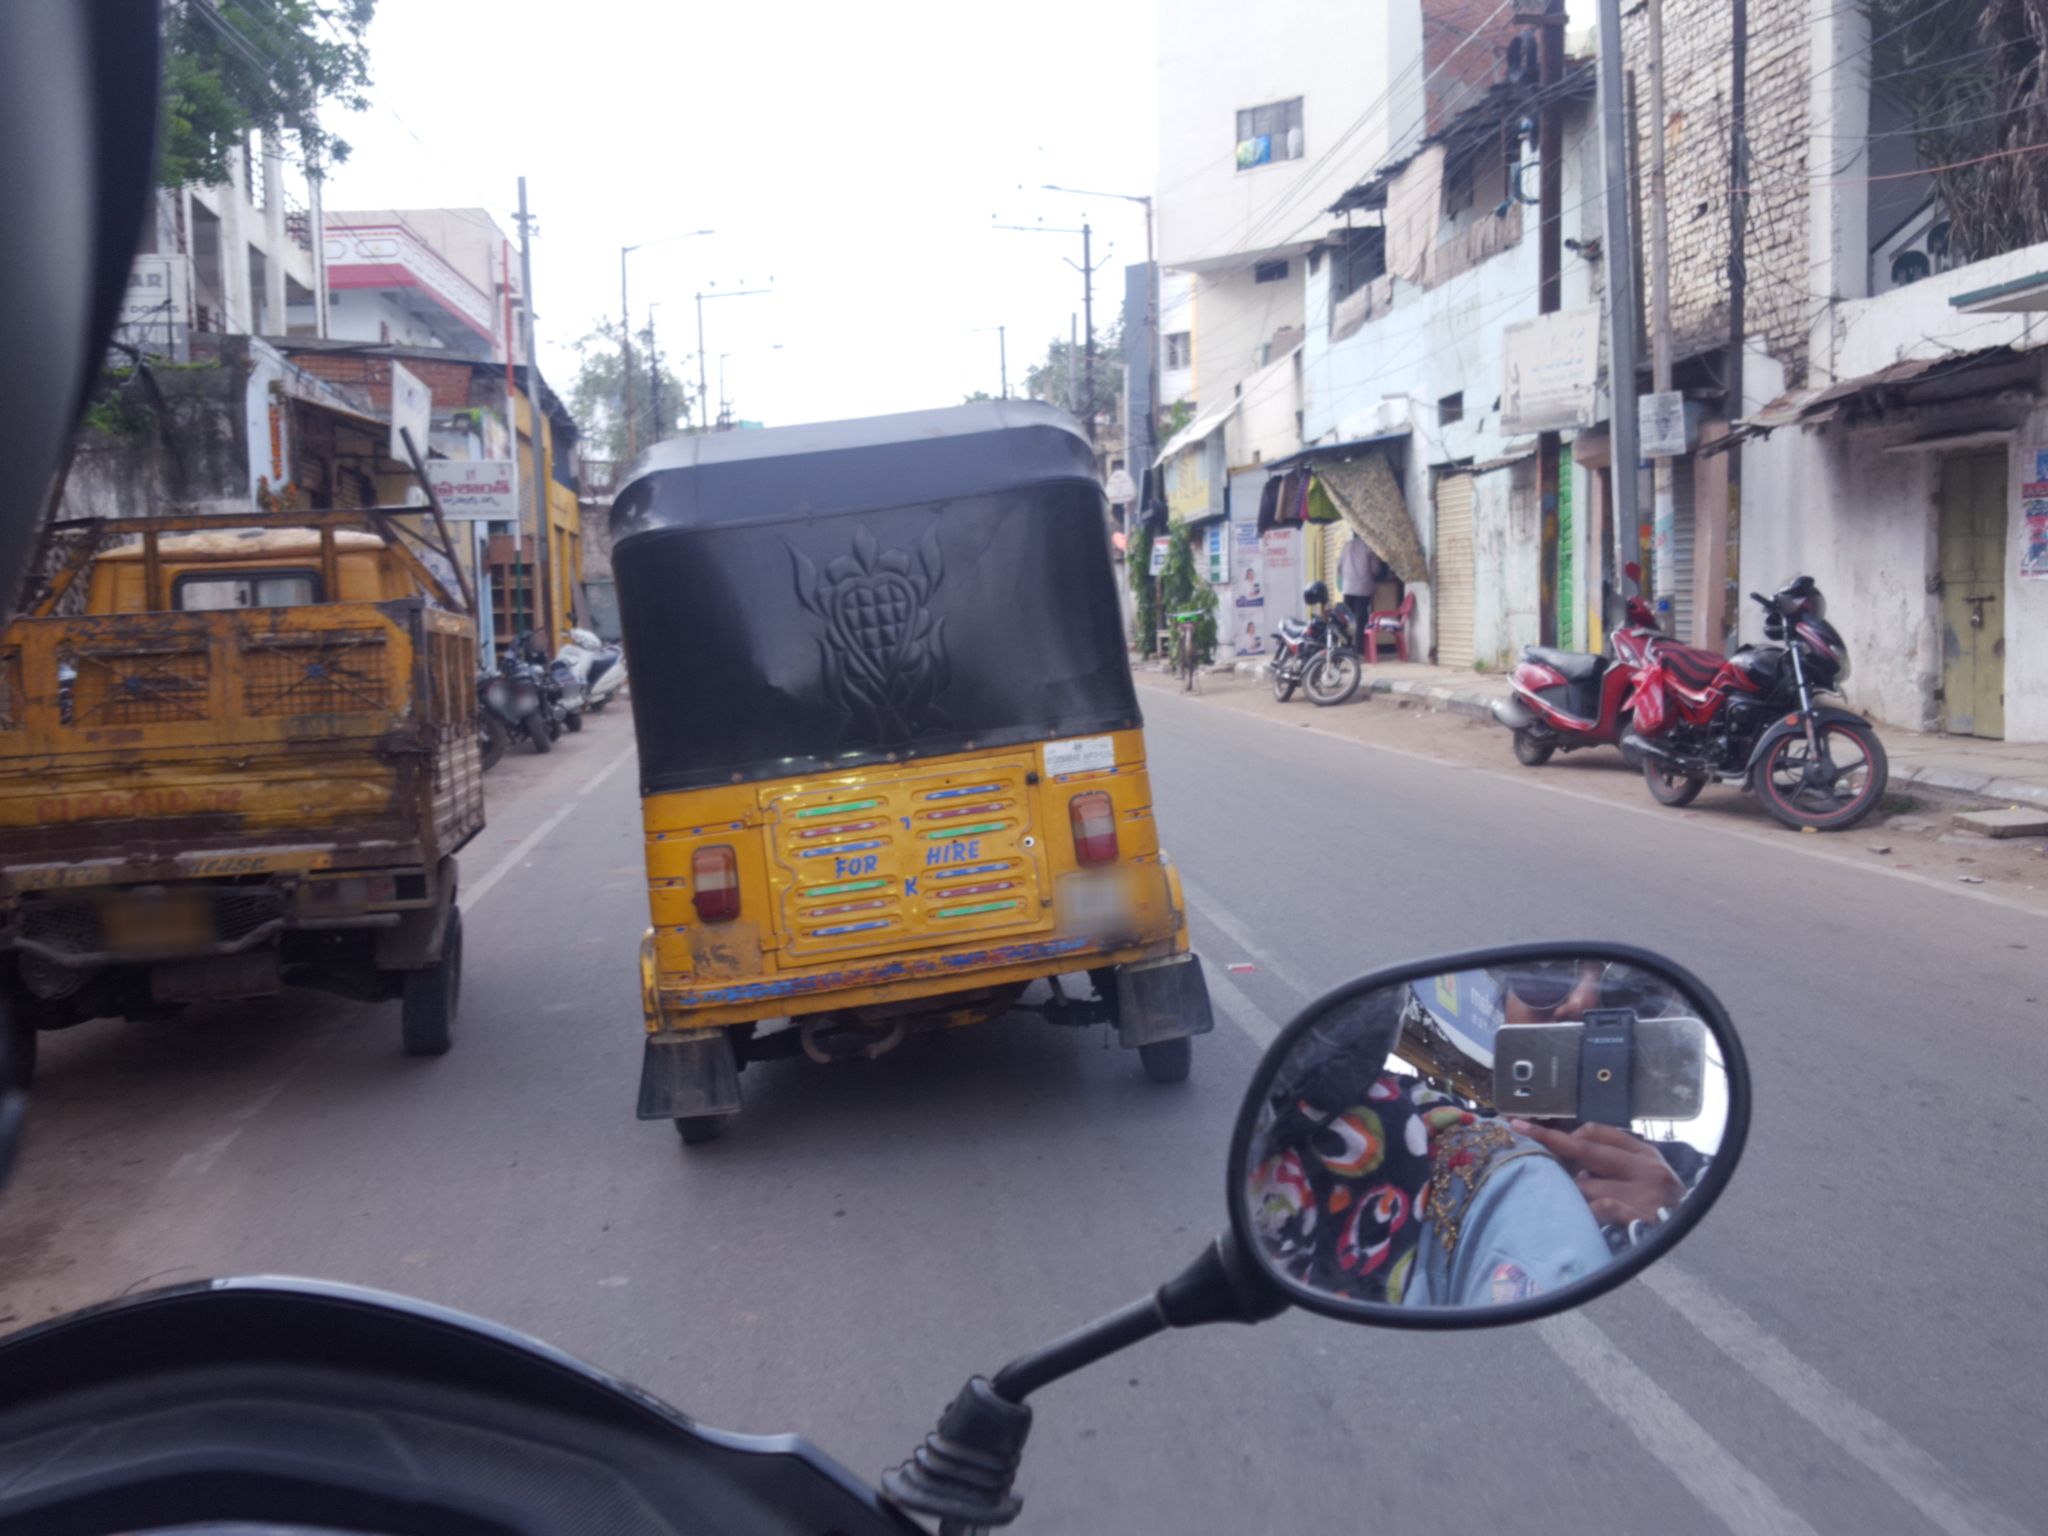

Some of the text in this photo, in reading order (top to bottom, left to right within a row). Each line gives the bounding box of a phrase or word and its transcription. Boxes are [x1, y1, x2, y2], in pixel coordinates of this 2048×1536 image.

[36, 787, 190, 822] PIAGGIO
[835, 840, 980, 878] FOR HIRE
[903, 875, 919, 897] K
